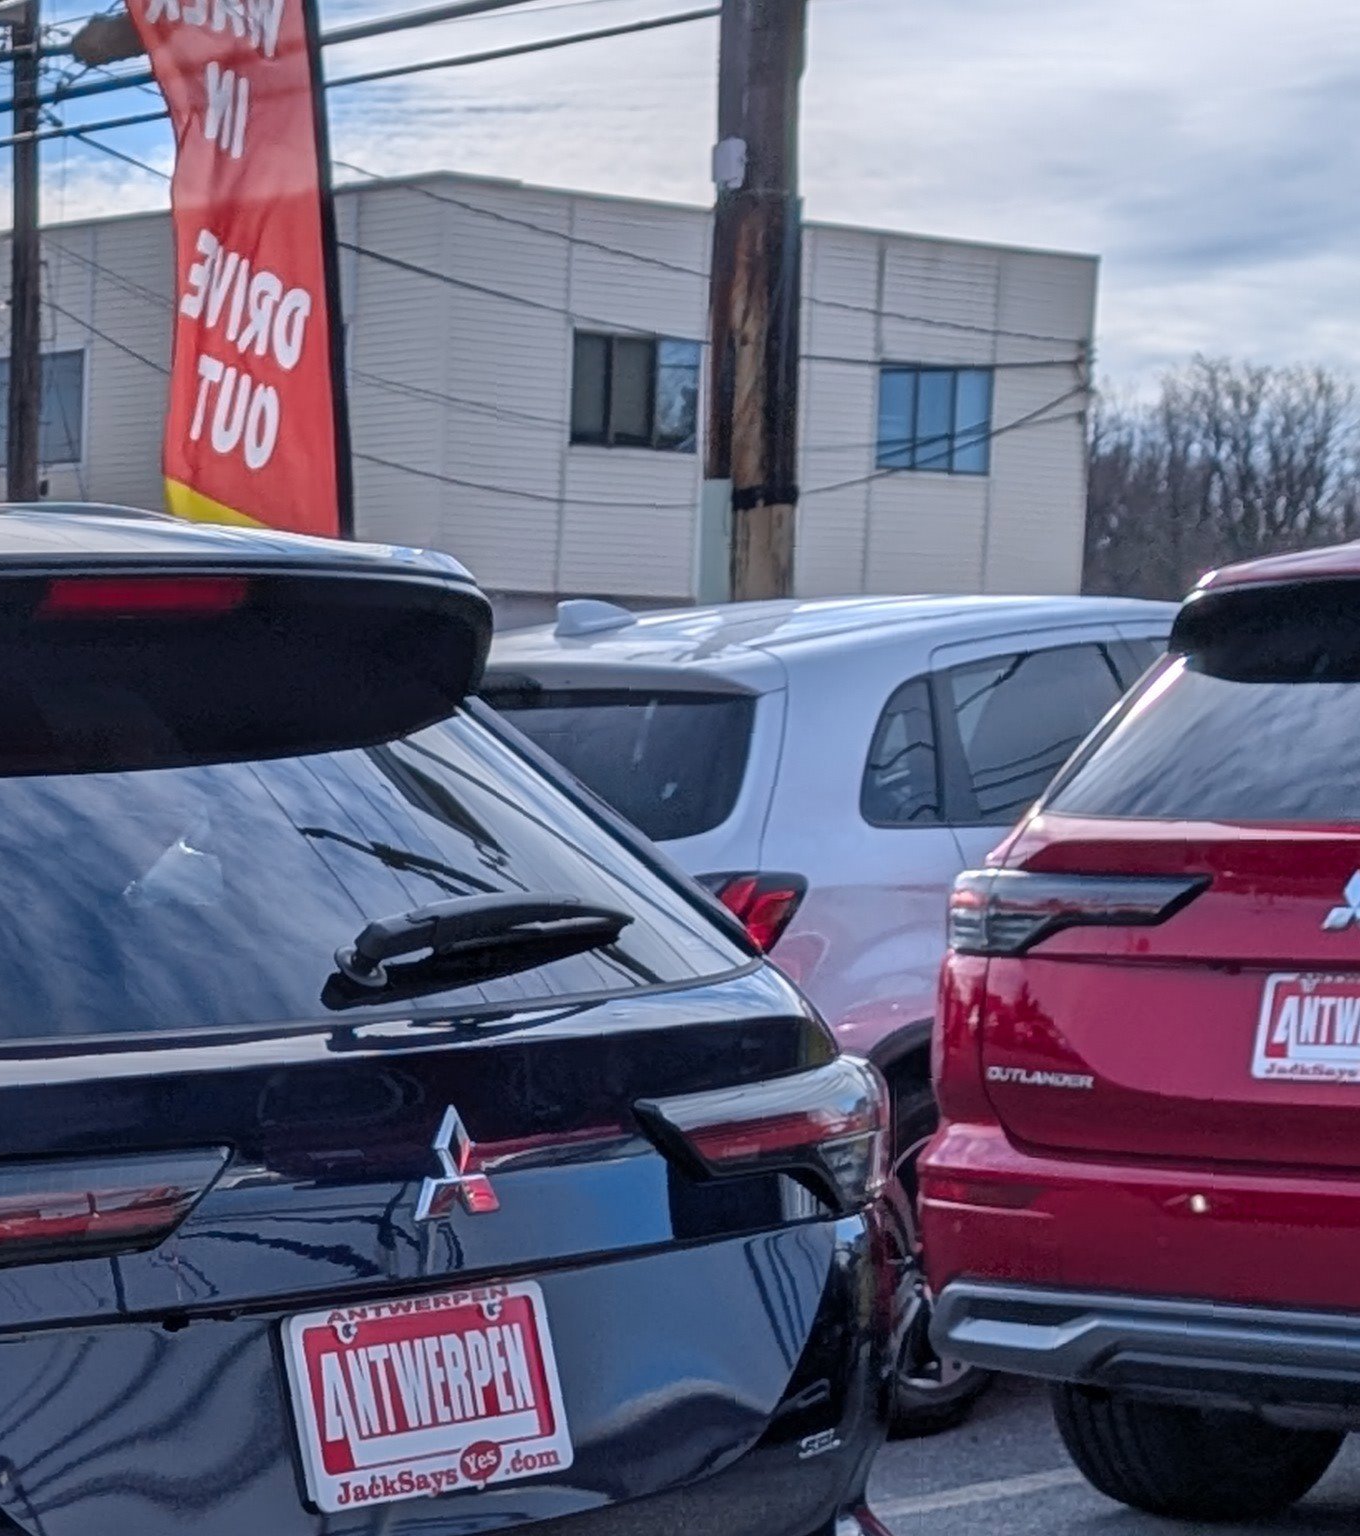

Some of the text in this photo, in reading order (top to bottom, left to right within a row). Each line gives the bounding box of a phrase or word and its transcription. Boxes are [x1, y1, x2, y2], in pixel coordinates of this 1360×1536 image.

[1271, 994, 1360, 1044] ANTW
[986, 1065, 1095, 1090] OUTLANDER
[326, 1285, 510, 1325] ANTWERPEN
[320, 1322, 537, 1444] ANTWERPEN
